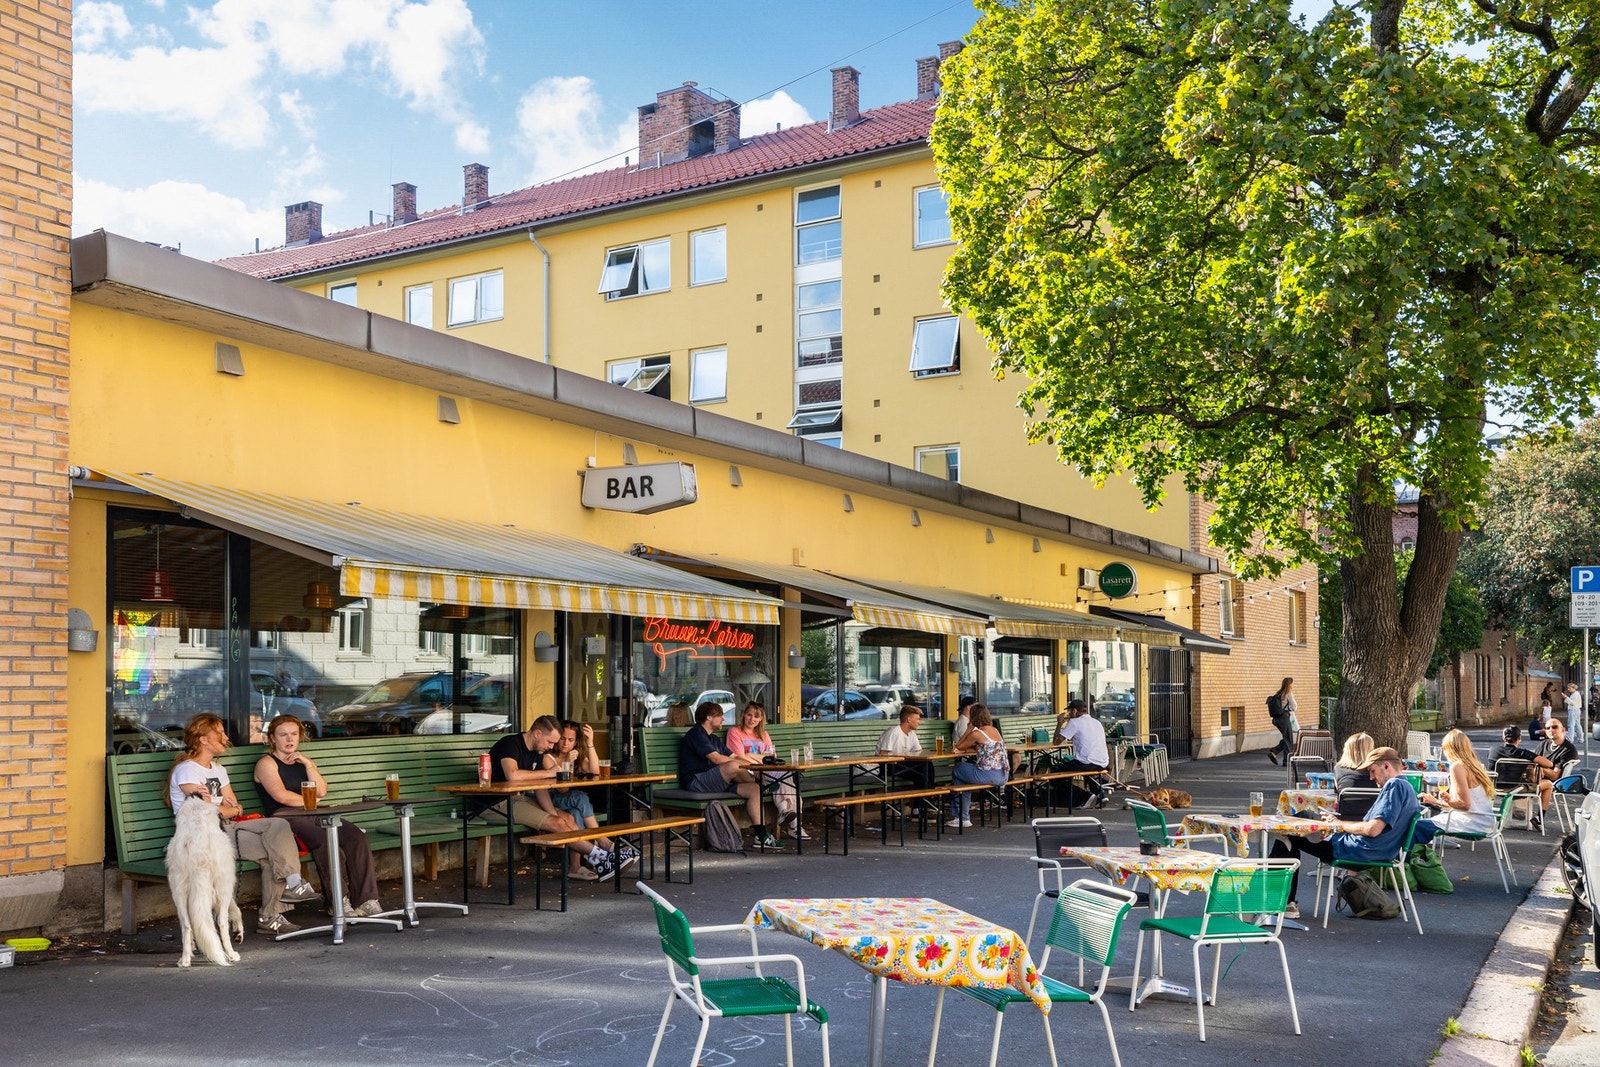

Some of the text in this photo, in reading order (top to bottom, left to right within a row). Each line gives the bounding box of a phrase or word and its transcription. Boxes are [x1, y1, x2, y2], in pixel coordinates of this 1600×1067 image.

[606, 475, 654, 499] BAR
[1102, 576, 1131, 584] Lasarett
[1578, 570, 1594, 590] P
